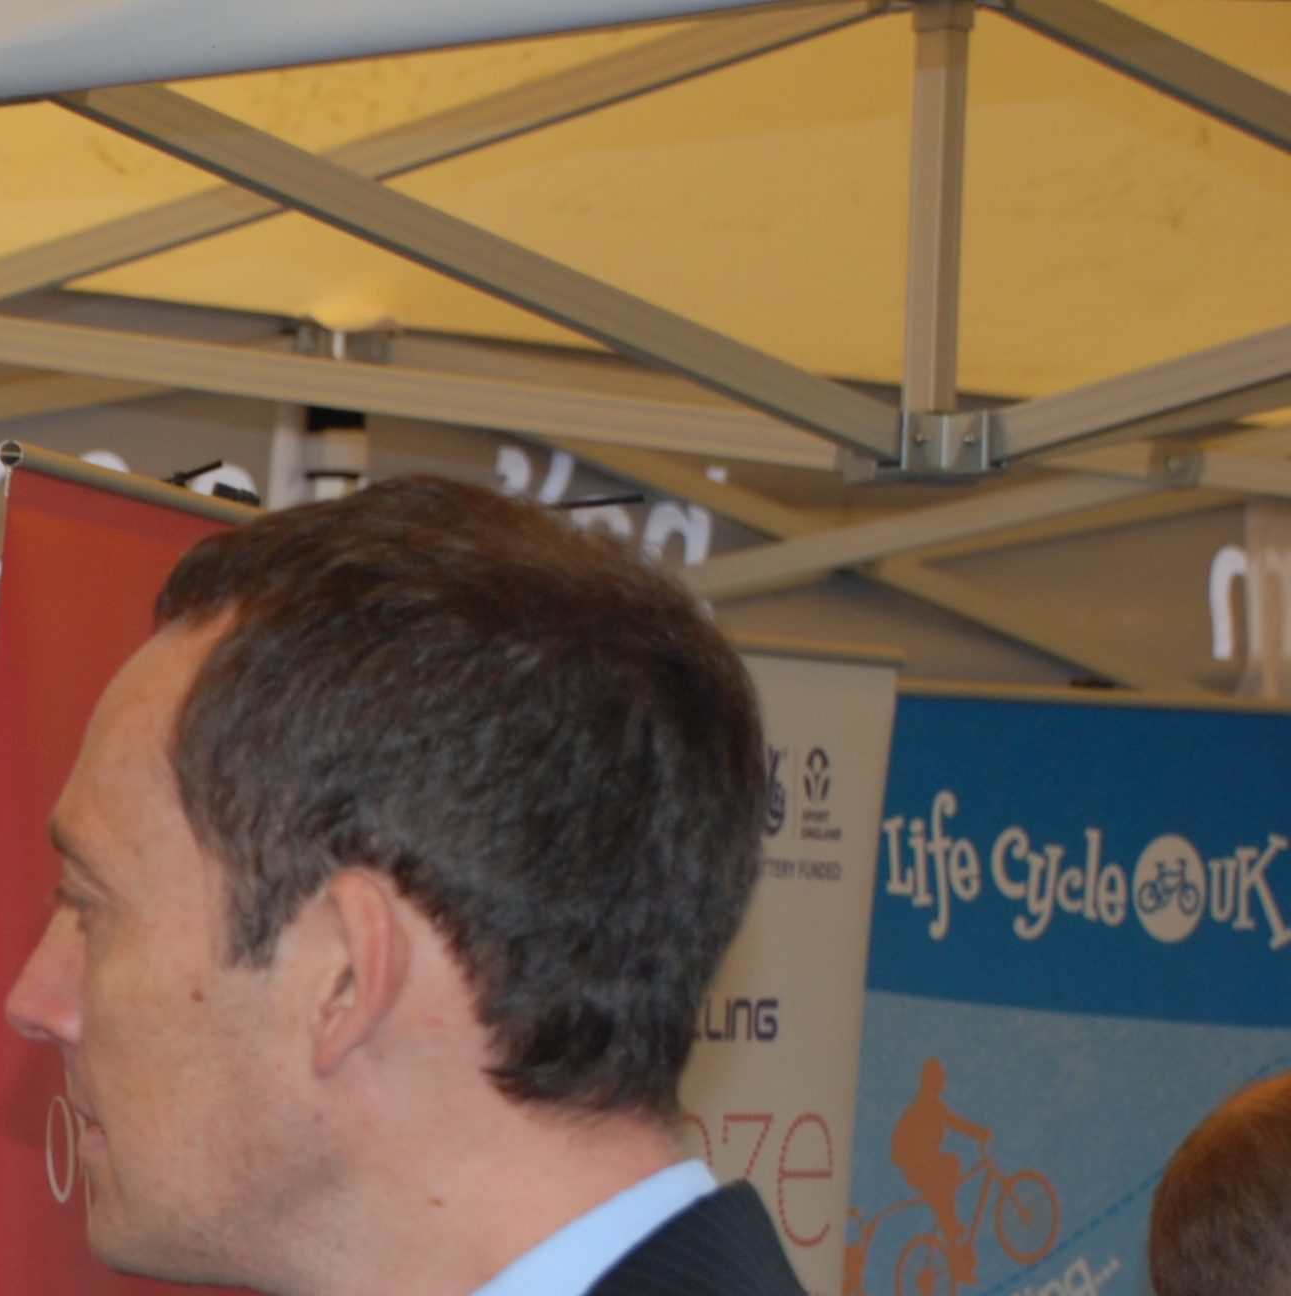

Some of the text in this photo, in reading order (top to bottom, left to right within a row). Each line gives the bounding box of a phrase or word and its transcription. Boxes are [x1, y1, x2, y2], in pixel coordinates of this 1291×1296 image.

[883, 790, 981, 940] Life
[991, 826, 1128, 940] Cycle
[693, 998, 778, 1041] LING
